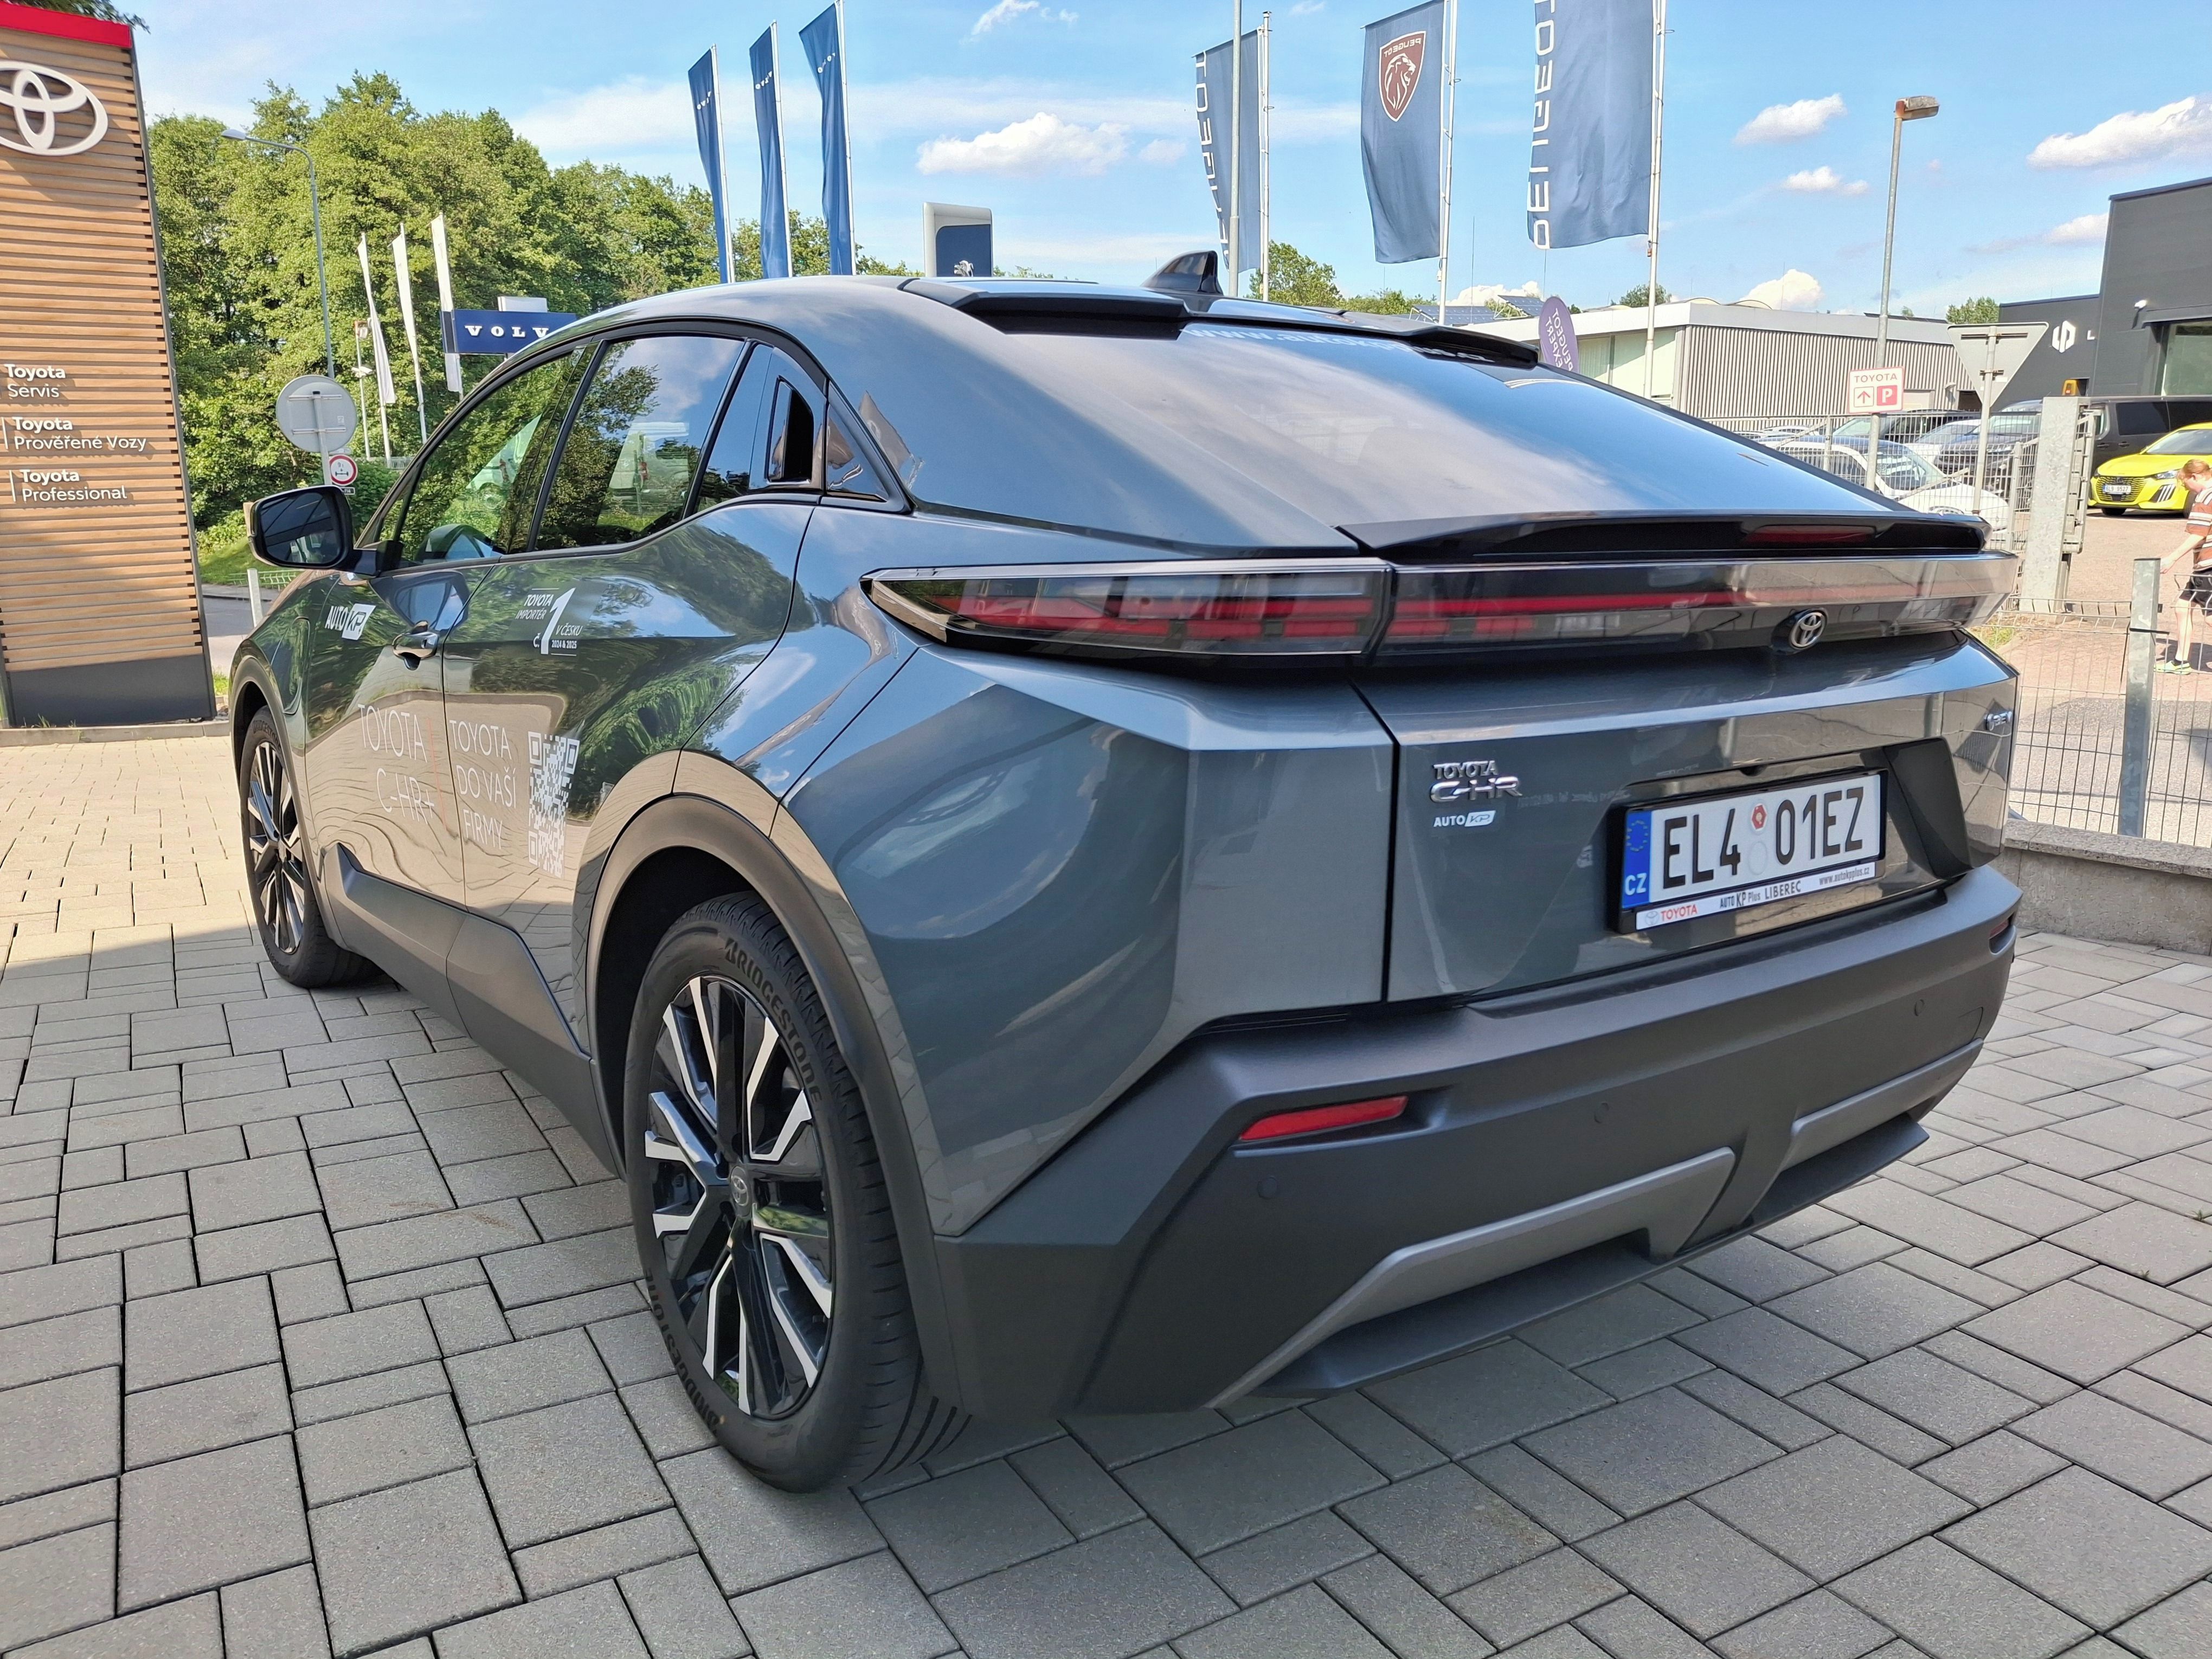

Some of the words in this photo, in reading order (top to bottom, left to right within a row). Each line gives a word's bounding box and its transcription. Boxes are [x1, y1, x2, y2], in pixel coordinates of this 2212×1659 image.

[465, 325, 549, 338] VOLV
[4, 364, 66, 381] Toyota
[1854, 373, 1898, 383] TOYOTA
[7, 384, 60, 398] Servis
[1882, 388, 1893, 403] P
[12, 416, 73, 434] Toyota
[14, 435, 103, 451] Prověřené
[106, 435, 147, 452] Vozy
[20, 469, 80, 486] Toyota
[22, 485, 128, 502] Professional
[524, 594, 554, 606] TOYOTA
[541, 587, 576, 655] 1
[552, 640, 562, 648] 2024
[566, 640, 577, 649] 2025
[358, 704, 427, 763] TOYOTA
[449, 720, 512, 759] TOYOTA
[1433, 760, 1499, 780] TOYOTA
[456, 765, 480, 799] DO
[482, 766, 516, 808] VAŠÍ
[377, 768, 435, 825] C-HR+
[463, 809, 503, 850] FIRMY
[1433, 815, 1465, 827] AUTO
[1663, 808, 1741, 889] EL4
[1776, 786, 1863, 865] 01EZ
[1625, 872, 1647, 895] CZ
[1661, 904, 1697, 921] TOYOTA
[1720, 896, 1735, 909] AUTO
[1736, 891, 1746, 907] KP
[1748, 892, 1760, 903] Plus
[1765, 880, 1802, 900] LIBEREC
[1819, 867, 1870, 886] www.autokpplus.cz
[725, 937, 822, 1103] BRIDGESTONE
